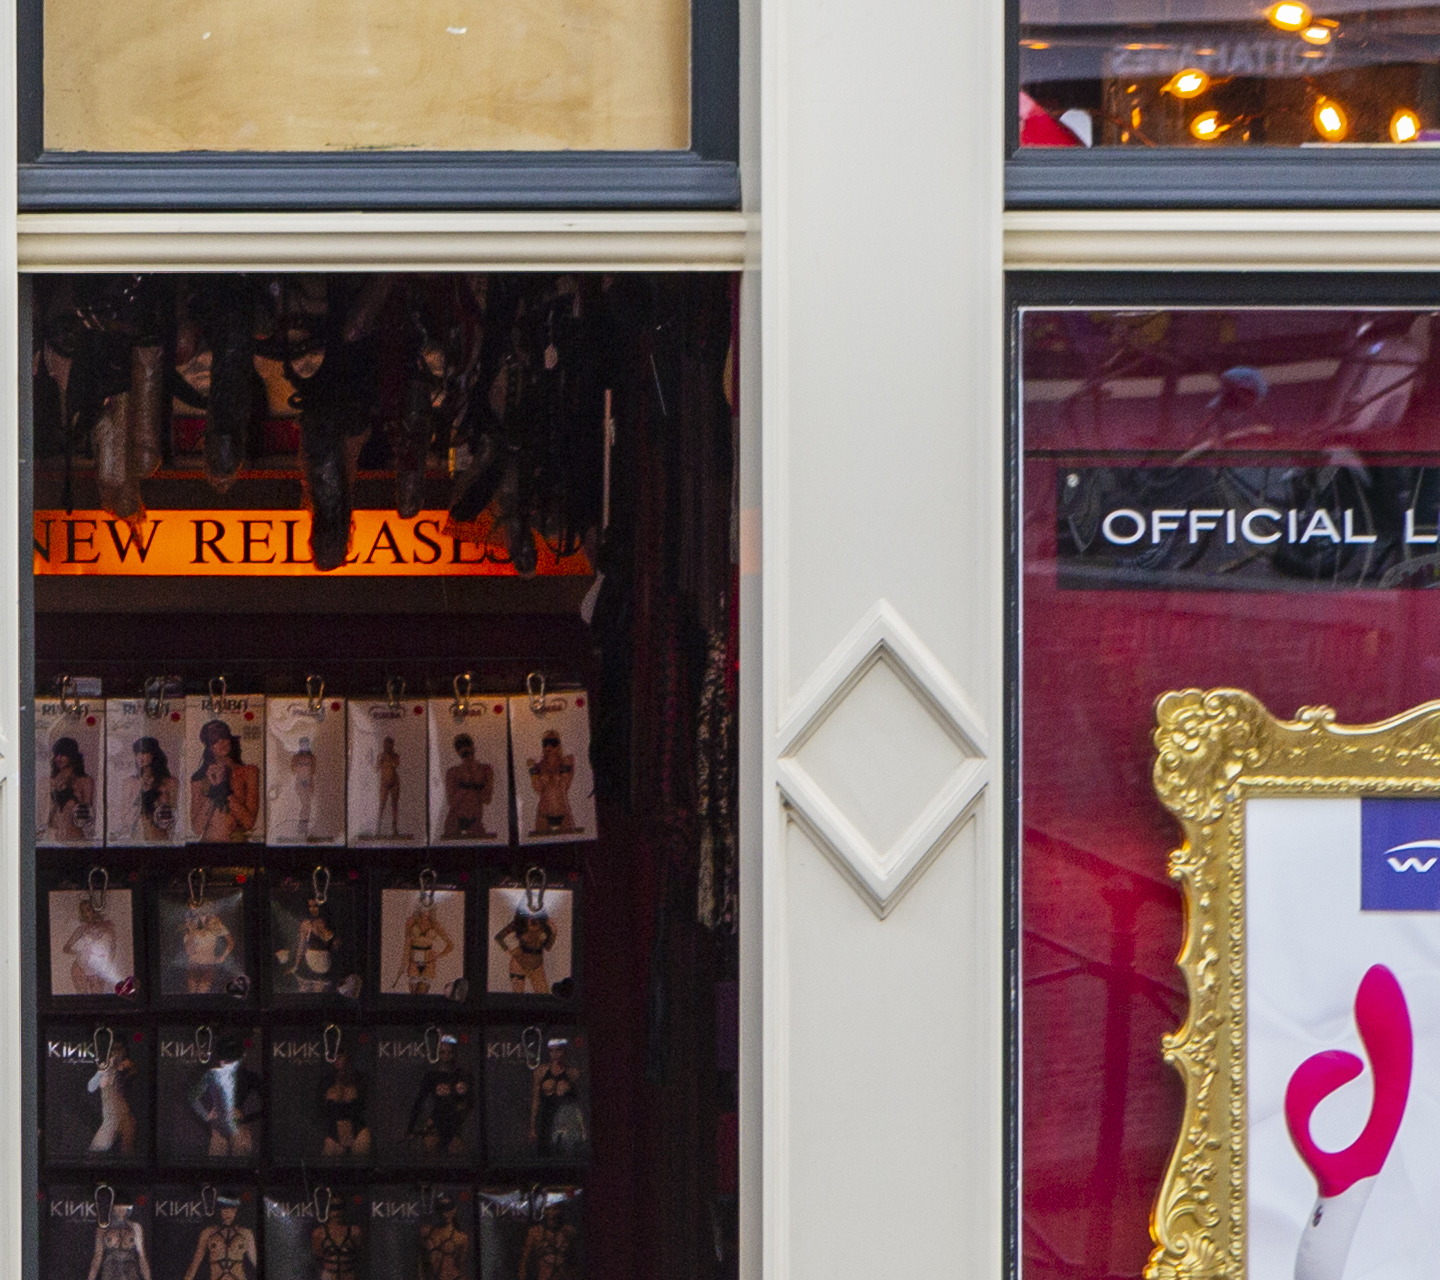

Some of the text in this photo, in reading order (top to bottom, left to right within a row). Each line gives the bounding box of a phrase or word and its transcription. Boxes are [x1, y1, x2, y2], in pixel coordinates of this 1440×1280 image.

[34, 520, 512, 565] NEW RELASE
[1101, 507, 1378, 546] OFFICIAL
